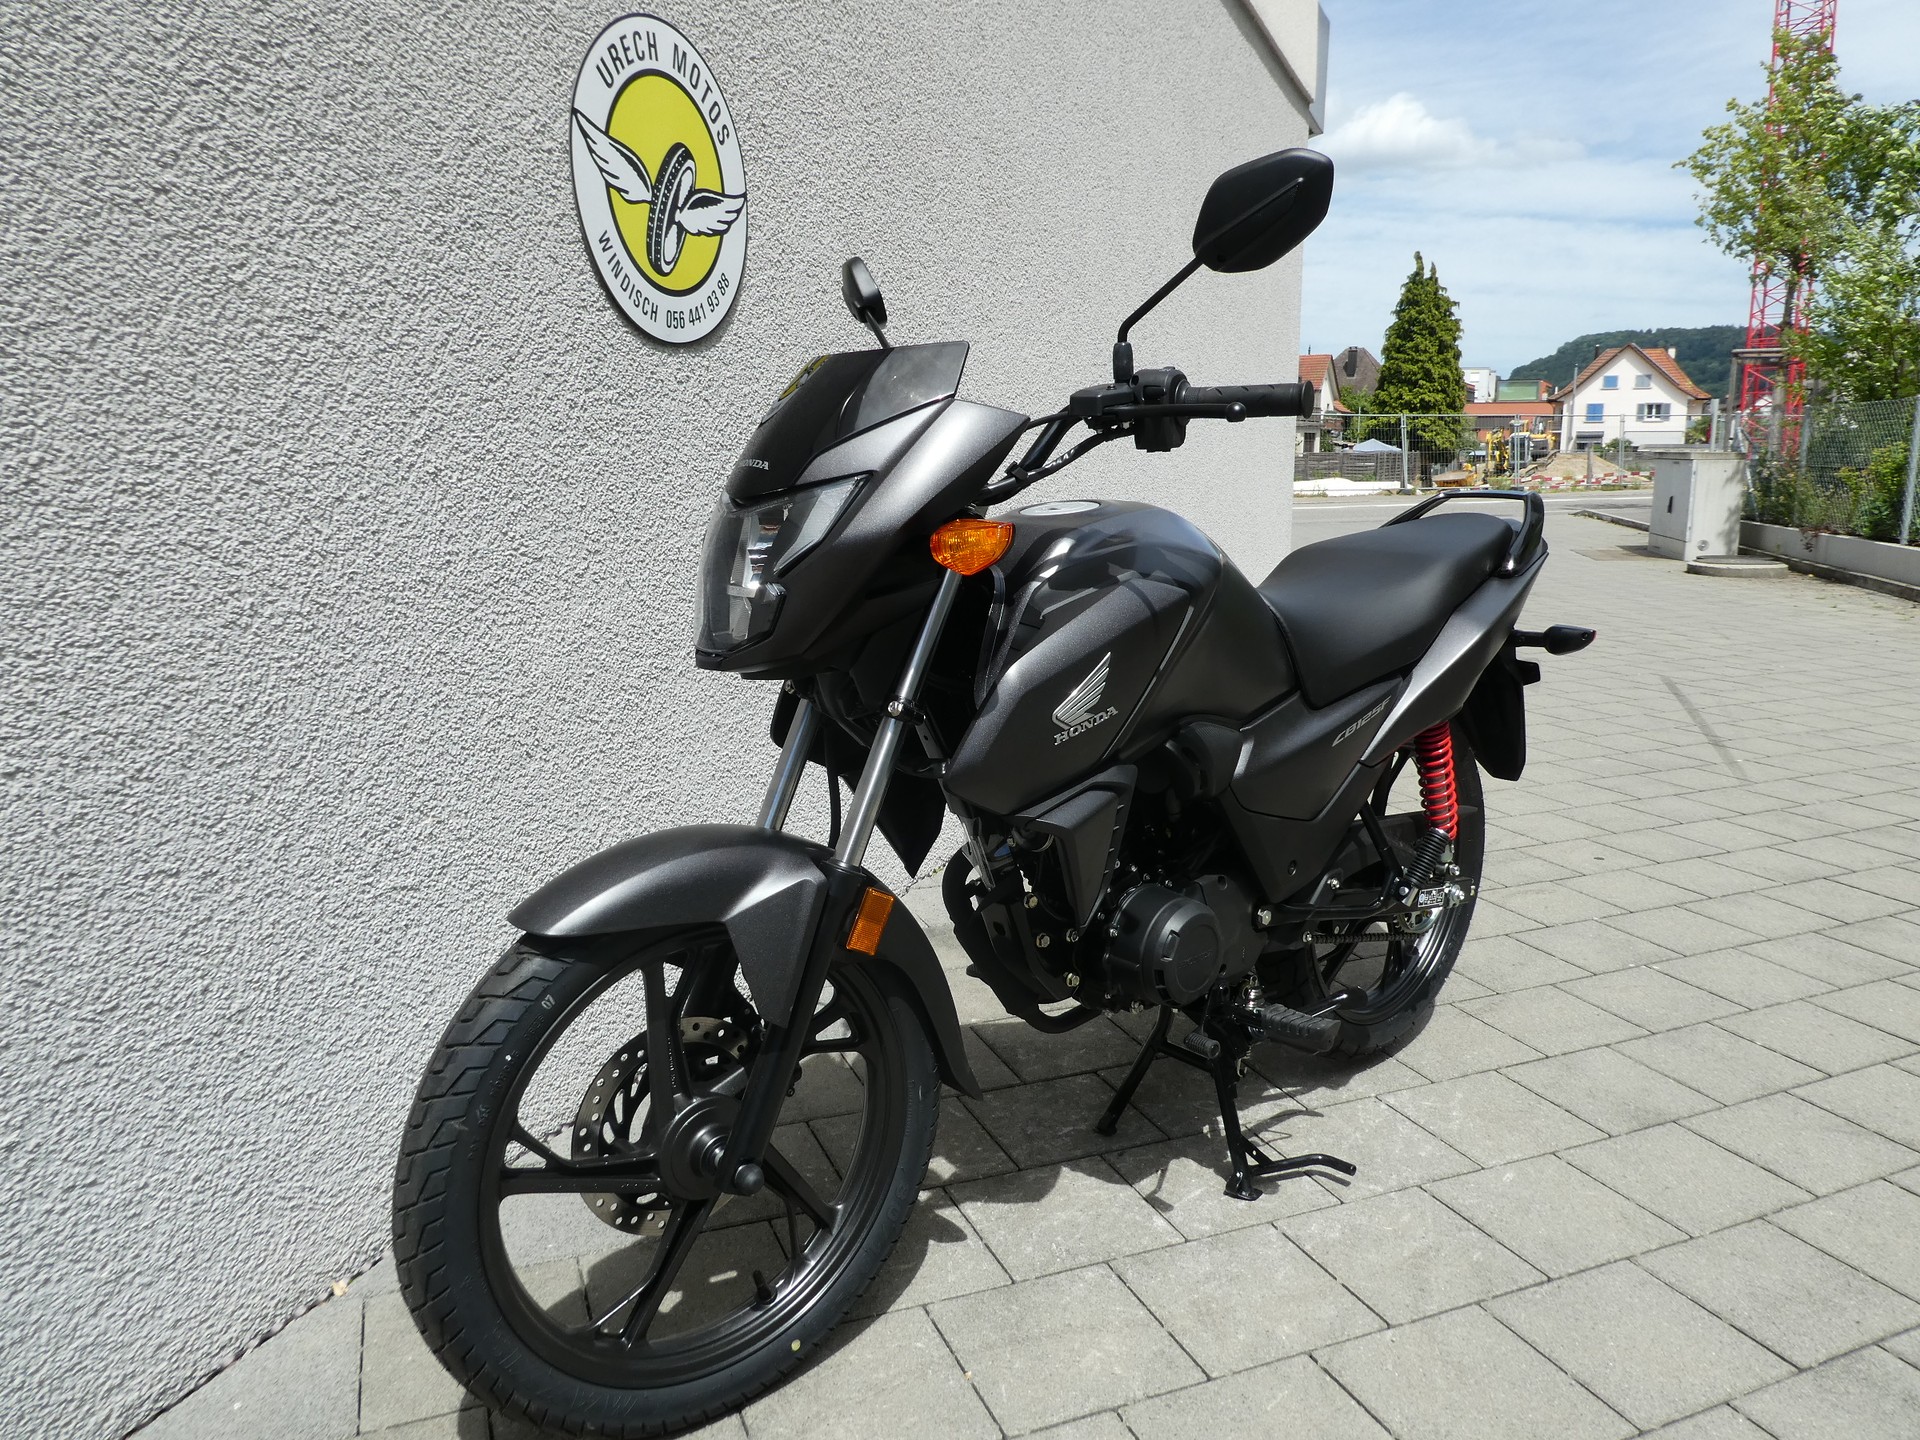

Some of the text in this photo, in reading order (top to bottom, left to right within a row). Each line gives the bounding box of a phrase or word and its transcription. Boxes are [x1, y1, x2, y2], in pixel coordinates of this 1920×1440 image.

[596, 30, 730, 146] URECH MOTOS
[598, 229, 730, 329] WINDISCH 056 441 93 88
[740, 458, 769, 470] ONDA
[1053, 706, 1118, 745] HONDA
[1331, 695, 1391, 747] CB125F
